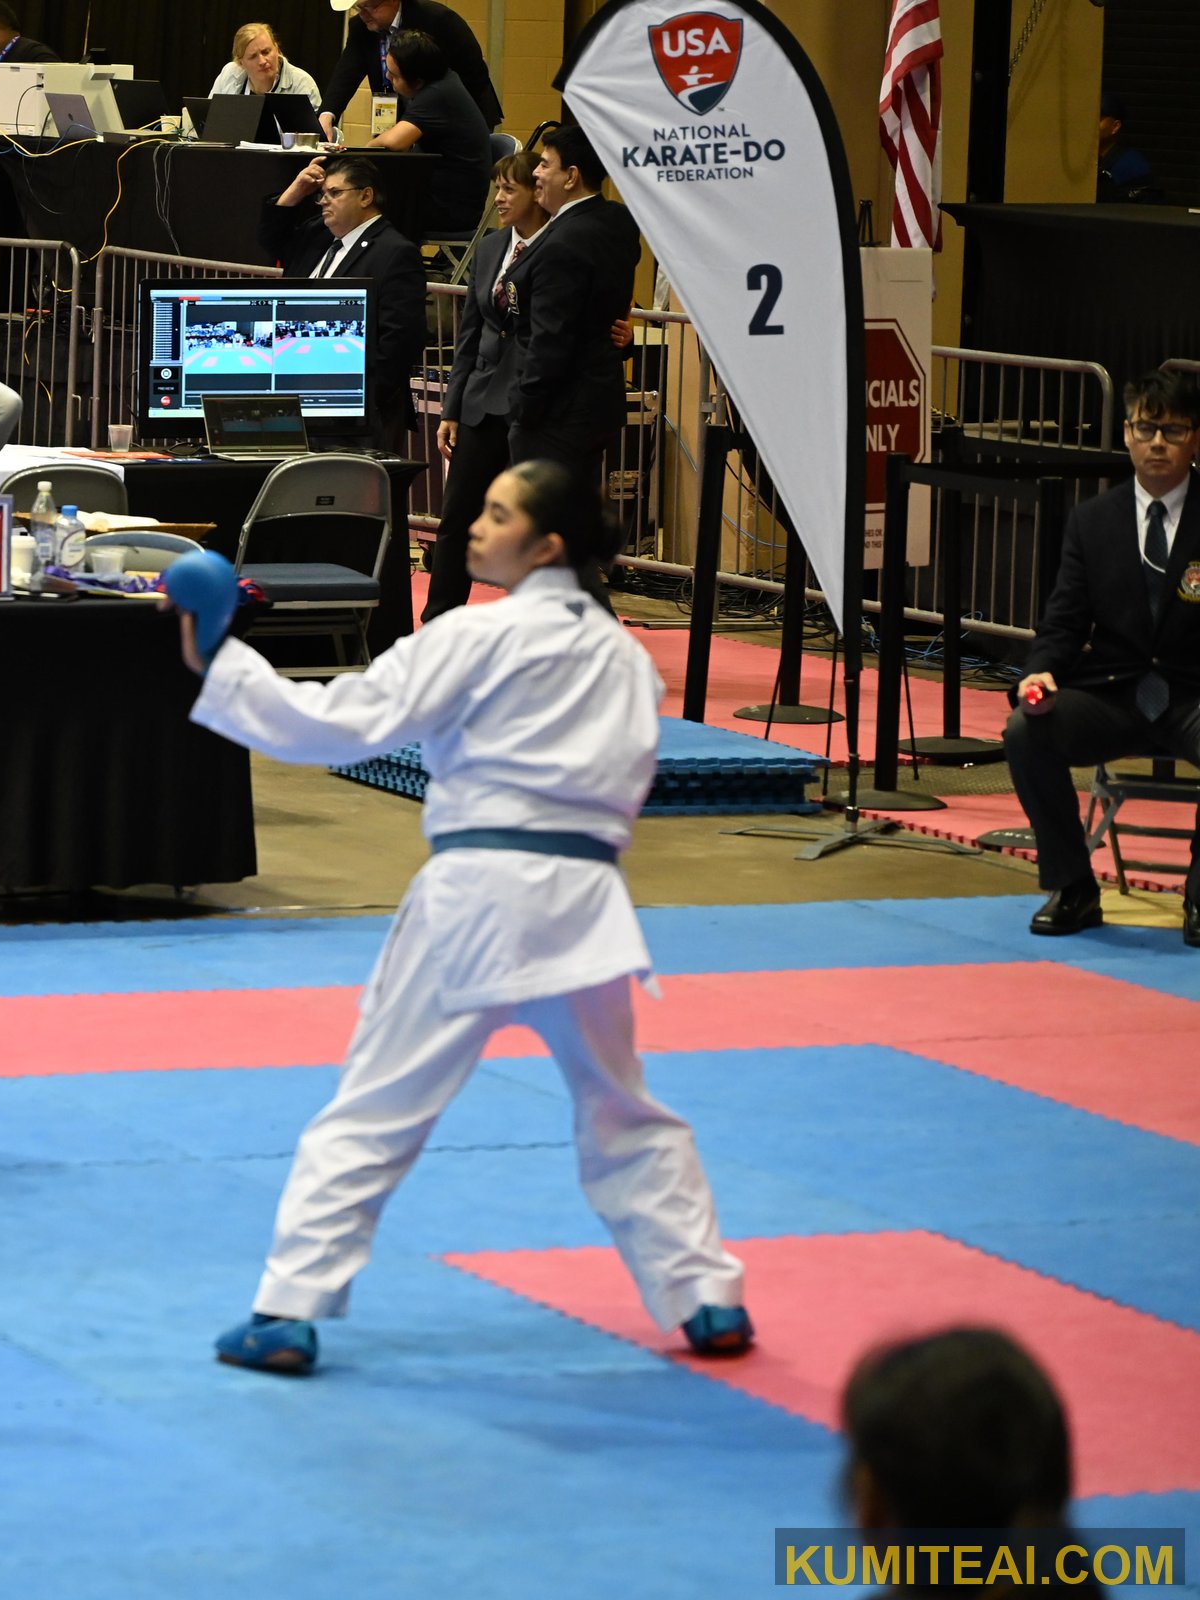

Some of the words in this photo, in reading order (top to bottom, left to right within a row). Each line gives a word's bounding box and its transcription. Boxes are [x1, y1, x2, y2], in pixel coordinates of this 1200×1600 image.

[662, 27, 731, 58] USA
[653, 124, 752, 142] NATIONAL
[622, 139, 786, 168] KARATE-DO
[657, 167, 754, 183] FEDERATION
[746, 263, 785, 336] 2
